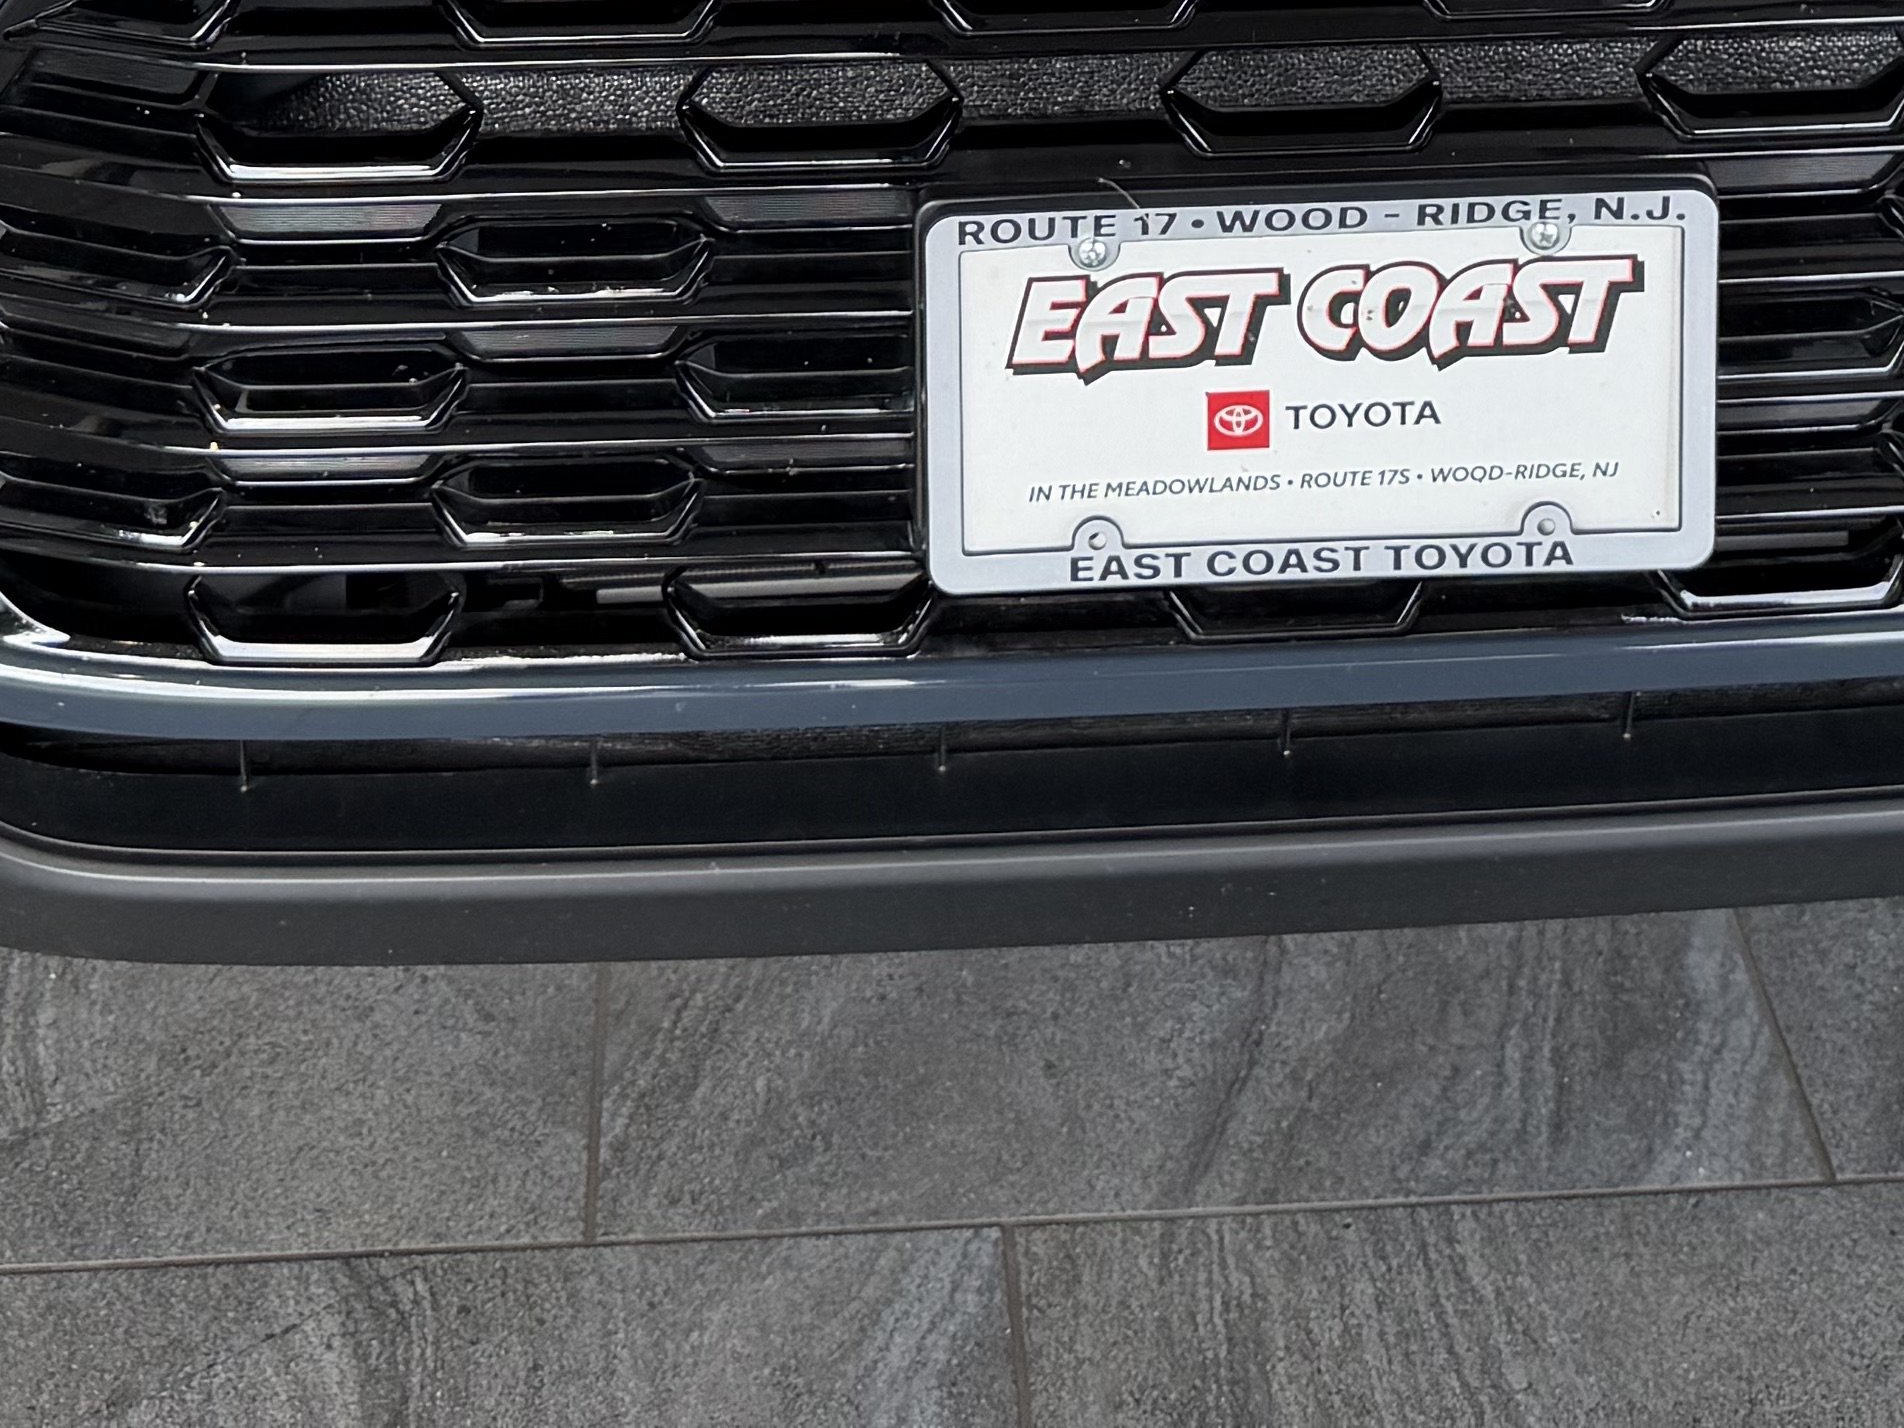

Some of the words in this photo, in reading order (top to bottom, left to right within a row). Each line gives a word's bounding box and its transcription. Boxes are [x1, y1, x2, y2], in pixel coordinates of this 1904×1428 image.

[958, 214, 1117, 246] ROUTE
[1133, 211, 1179, 237] 17
[1216, 206, 1368, 234] WOOD
[1416, 198, 1577, 228] RIDGE,
[1594, 196, 1687, 222] N.J.
[1005, 267, 1291, 386] EAST
[1297, 254, 1645, 372] COAST
[1285, 400, 1442, 430] TOYOTA
[1029, 485, 1052, 503] IN
[1058, 482, 1100, 500] THE
[1104, 474, 1281, 499] MEADOWLANDS
[1299, 469, 1374, 490] ROUTE
[1377, 468, 1412, 487] 17S
[1431, 462, 1586, 484] WOOD-RIDGE,
[1592, 461, 1620, 478] NJ
[1070, 552, 1191, 582] EAST
[1206, 545, 1370, 577] COAST
[1384, 540, 1574, 572] TOYOTA
